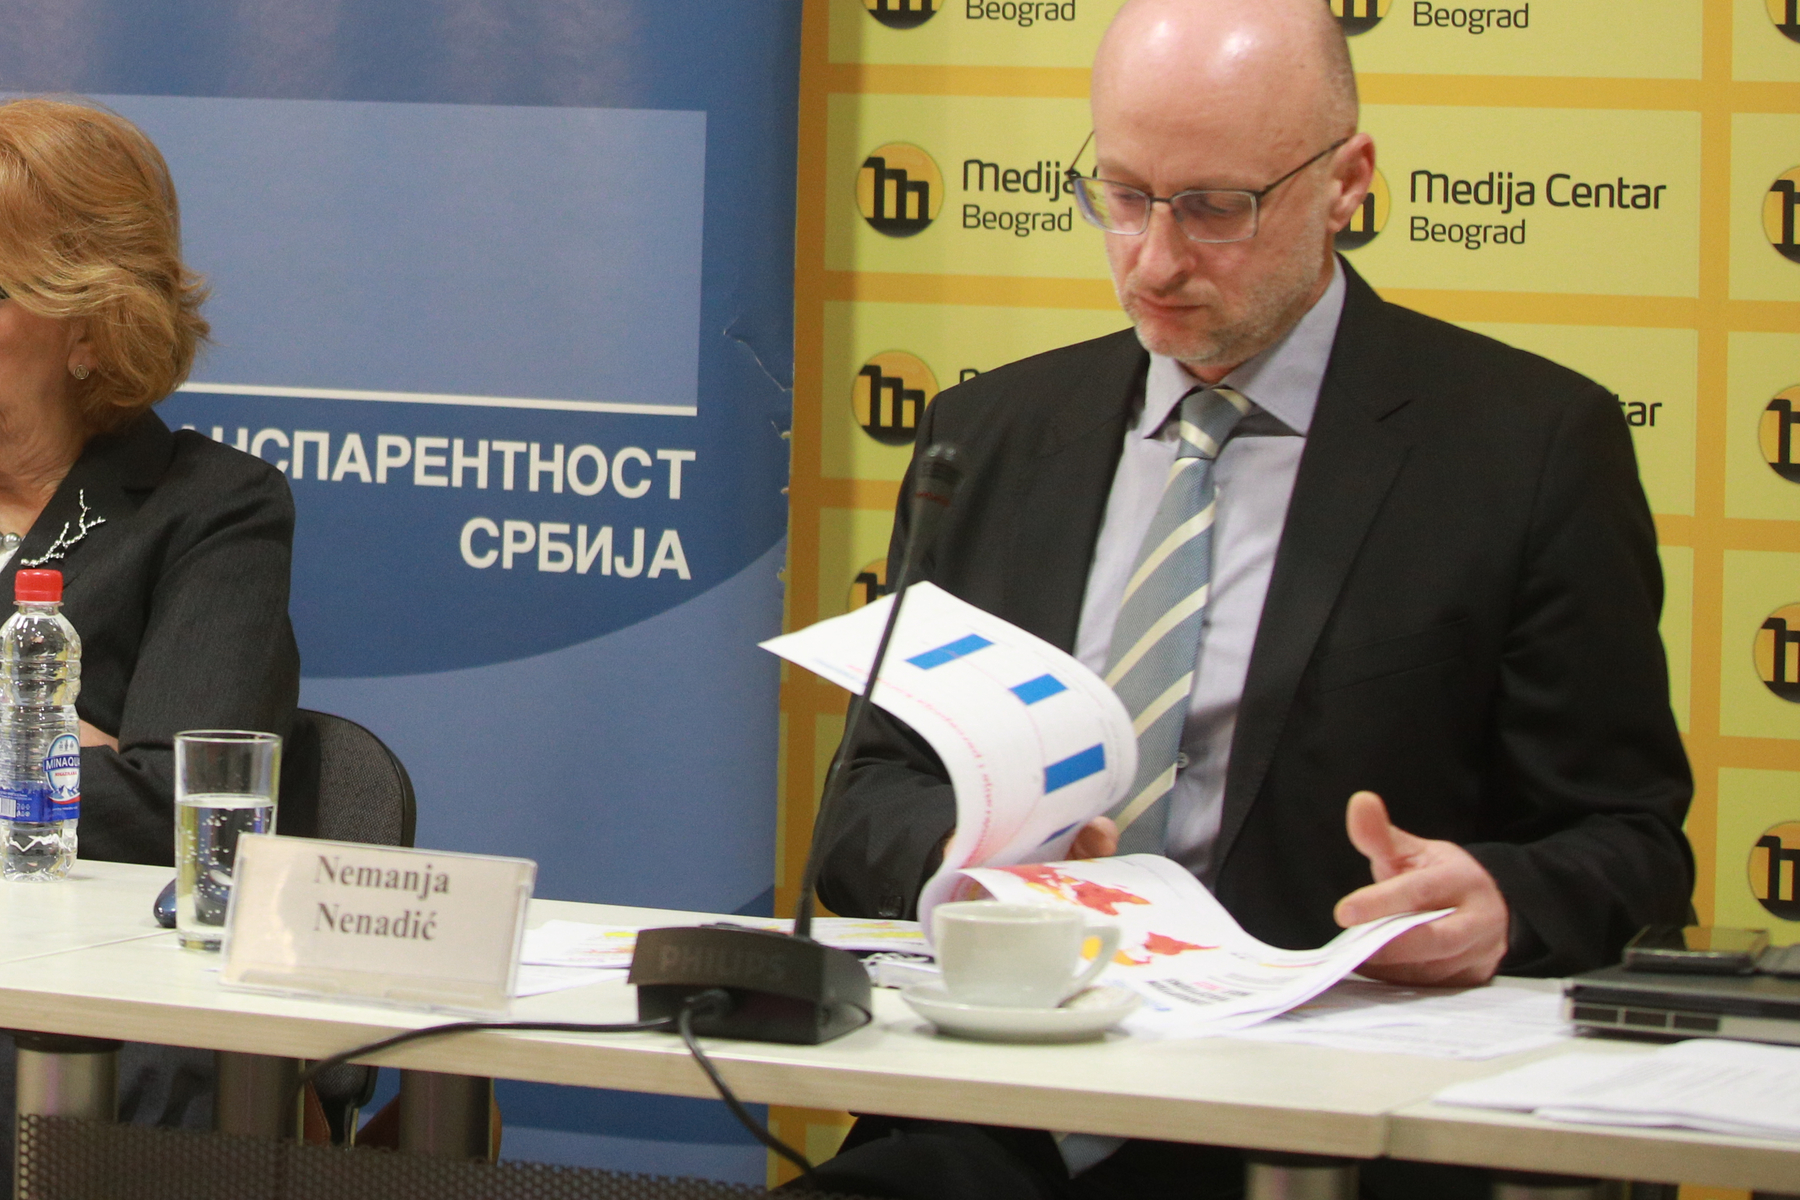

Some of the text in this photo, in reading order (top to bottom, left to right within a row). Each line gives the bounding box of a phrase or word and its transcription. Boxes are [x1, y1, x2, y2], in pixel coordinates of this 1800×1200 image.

[1412, 0, 1530, 36] Beograd
[1409, 168, 1668, 216] Medija Centar
[961, 203, 1073, 238] Beograd
[1409, 215, 1527, 251] Beograd
[459, 516, 693, 581] СРБИЈА
[313, 854, 450, 901] Nemanja
[313, 901, 438, 941] Nenadić
